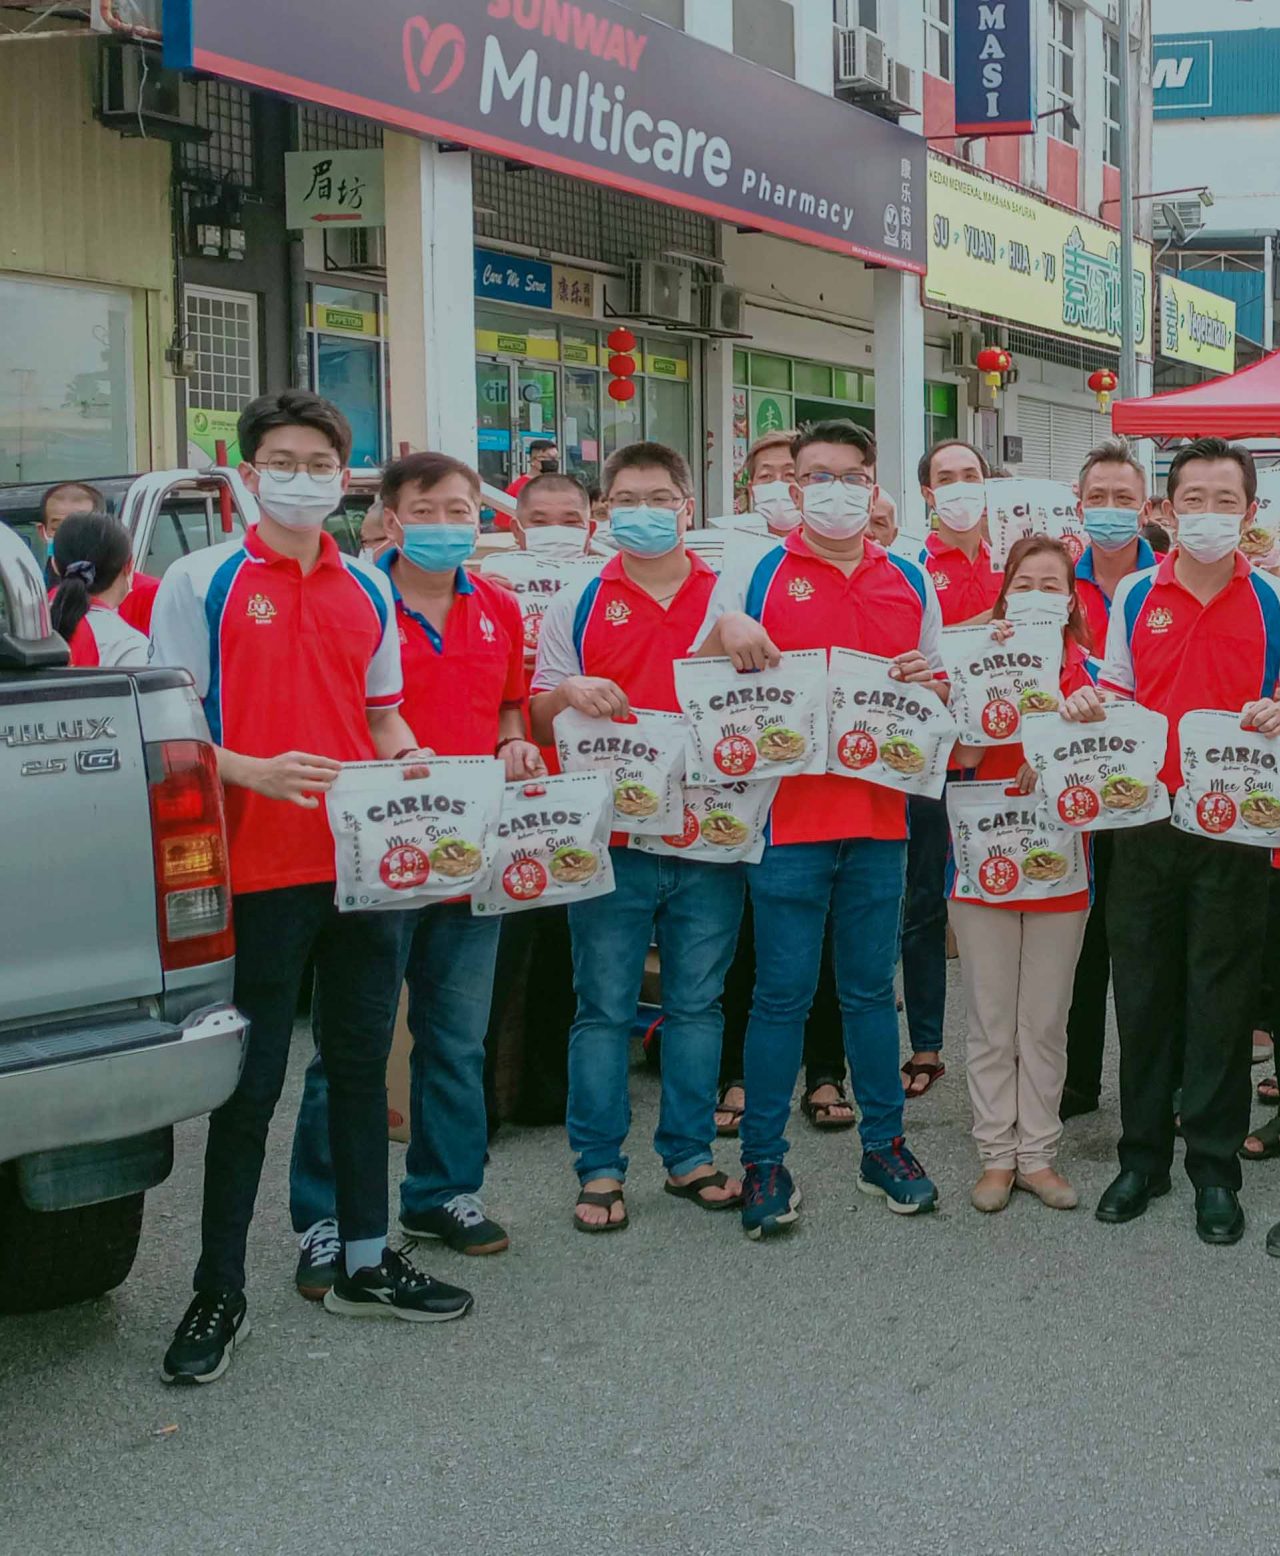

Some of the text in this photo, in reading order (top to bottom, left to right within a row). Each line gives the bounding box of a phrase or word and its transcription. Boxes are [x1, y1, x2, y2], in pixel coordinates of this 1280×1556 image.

[480, 35, 854, 231] Multicare Pharmacy
[303, 159, 366, 210] 眉坊
[933, 213, 950, 250] SU
[963, 223, 996, 266] YUAN
[1008, 239, 1031, 276] HUA
[1042, 251, 1056, 283] YU
[482, 264, 503, 286] Care
[1187, 300, 1227, 353] Vegetarian
[514, 578, 561, 594] CARL
[969, 652, 1043, 677] CARLOS
[709, 686, 796, 711] CARLOS
[854, 690, 933, 722] CARLOS
[986, 686, 1013, 701] Mee
[720, 723, 751, 738] Mee
[854, 720, 882, 734] Mee
[577, 737, 659, 763] CARLOS
[1053, 736, 1138, 761] CARLOS
[1206, 746, 1279, 774] CARLO
[1064, 772, 1096, 788] Mee
[1210, 778, 1241, 792] Mee
[366, 795, 466, 823] CARLOS
[978, 811, 1036, 832] CARL
[498, 810, 582, 838] CARLOS
[385, 834, 421, 849] Mee
[988, 845, 1017, 858] Mee
[511, 848, 544, 862] Mee
